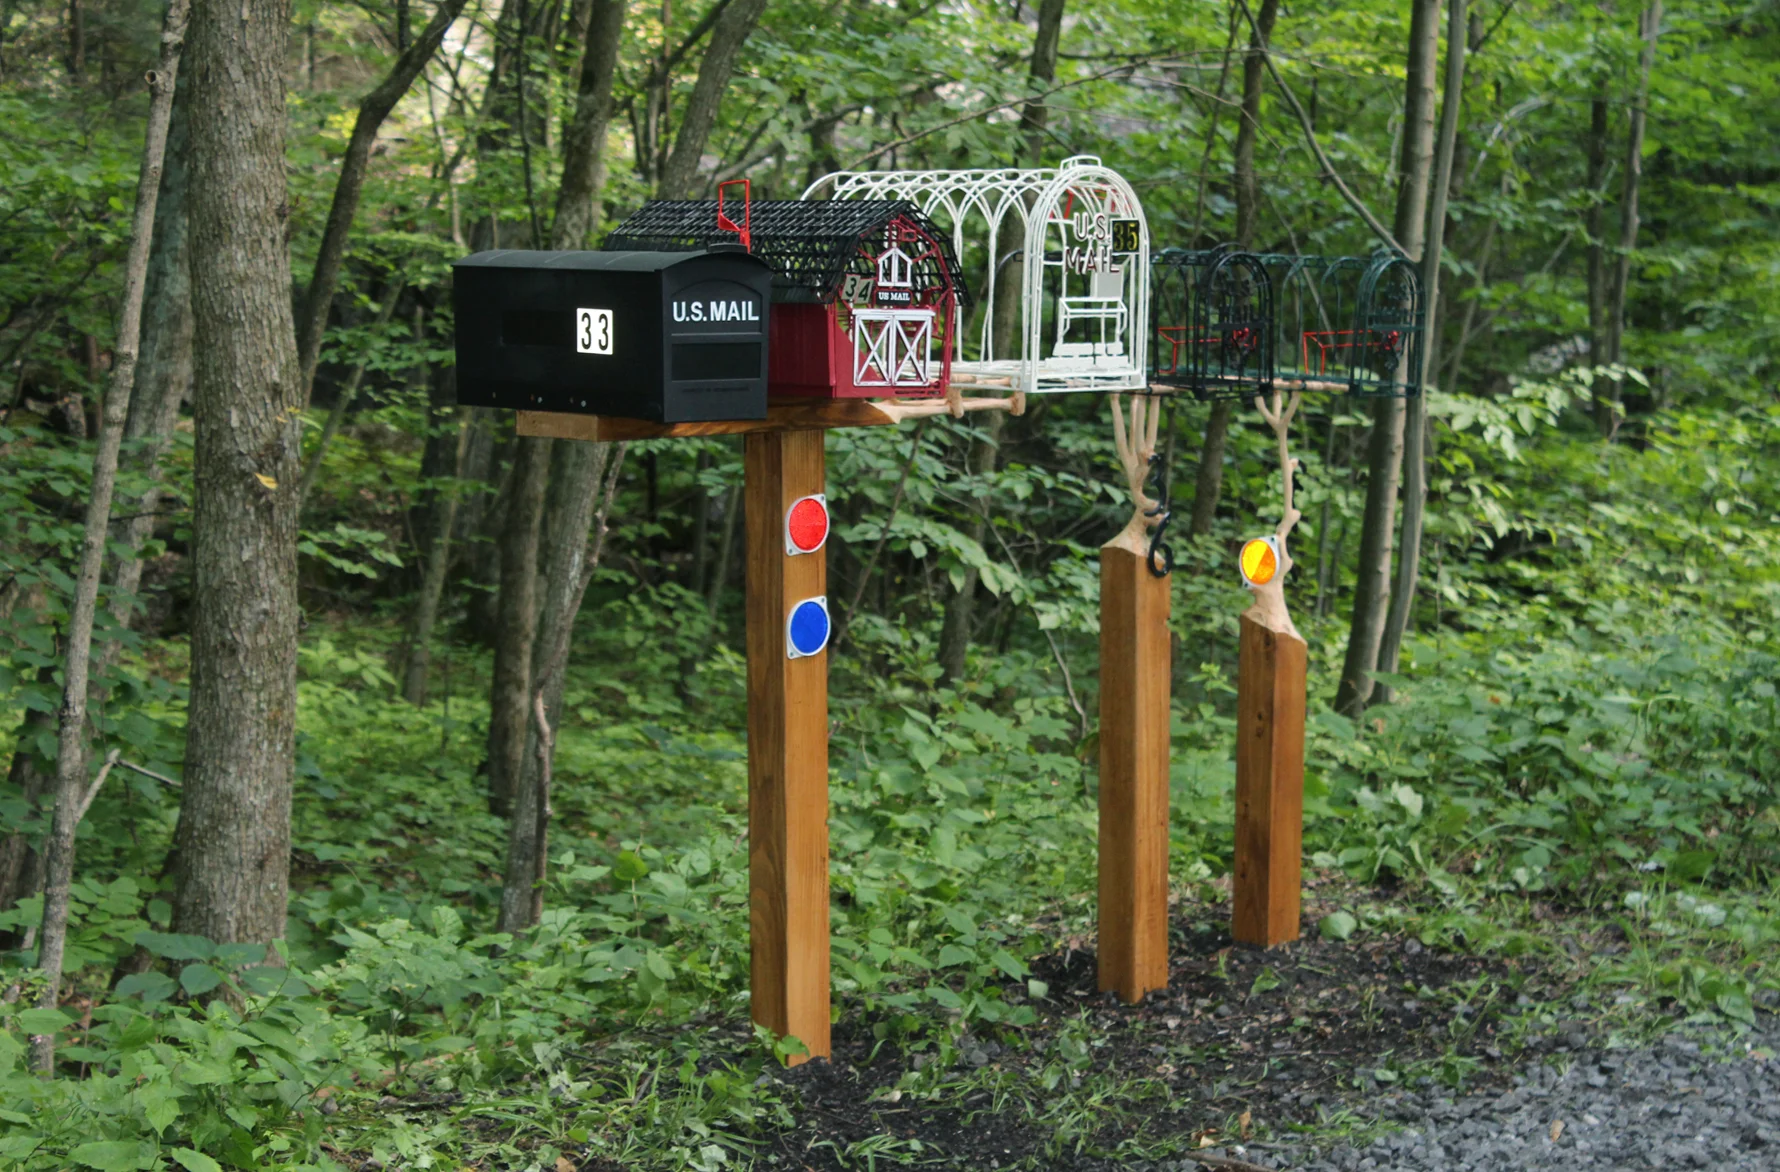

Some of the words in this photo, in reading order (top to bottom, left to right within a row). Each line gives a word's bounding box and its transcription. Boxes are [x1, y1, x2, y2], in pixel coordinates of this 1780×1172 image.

[1113, 222, 1138, 251] 35
[1064, 246, 1120, 275] MAIL
[844, 277, 871, 301] 34
[878, 292, 888, 301] US
[890, 292, 911, 301] MAIL
[709, 301, 760, 321] MAIL
[581, 312, 609, 351] 33
